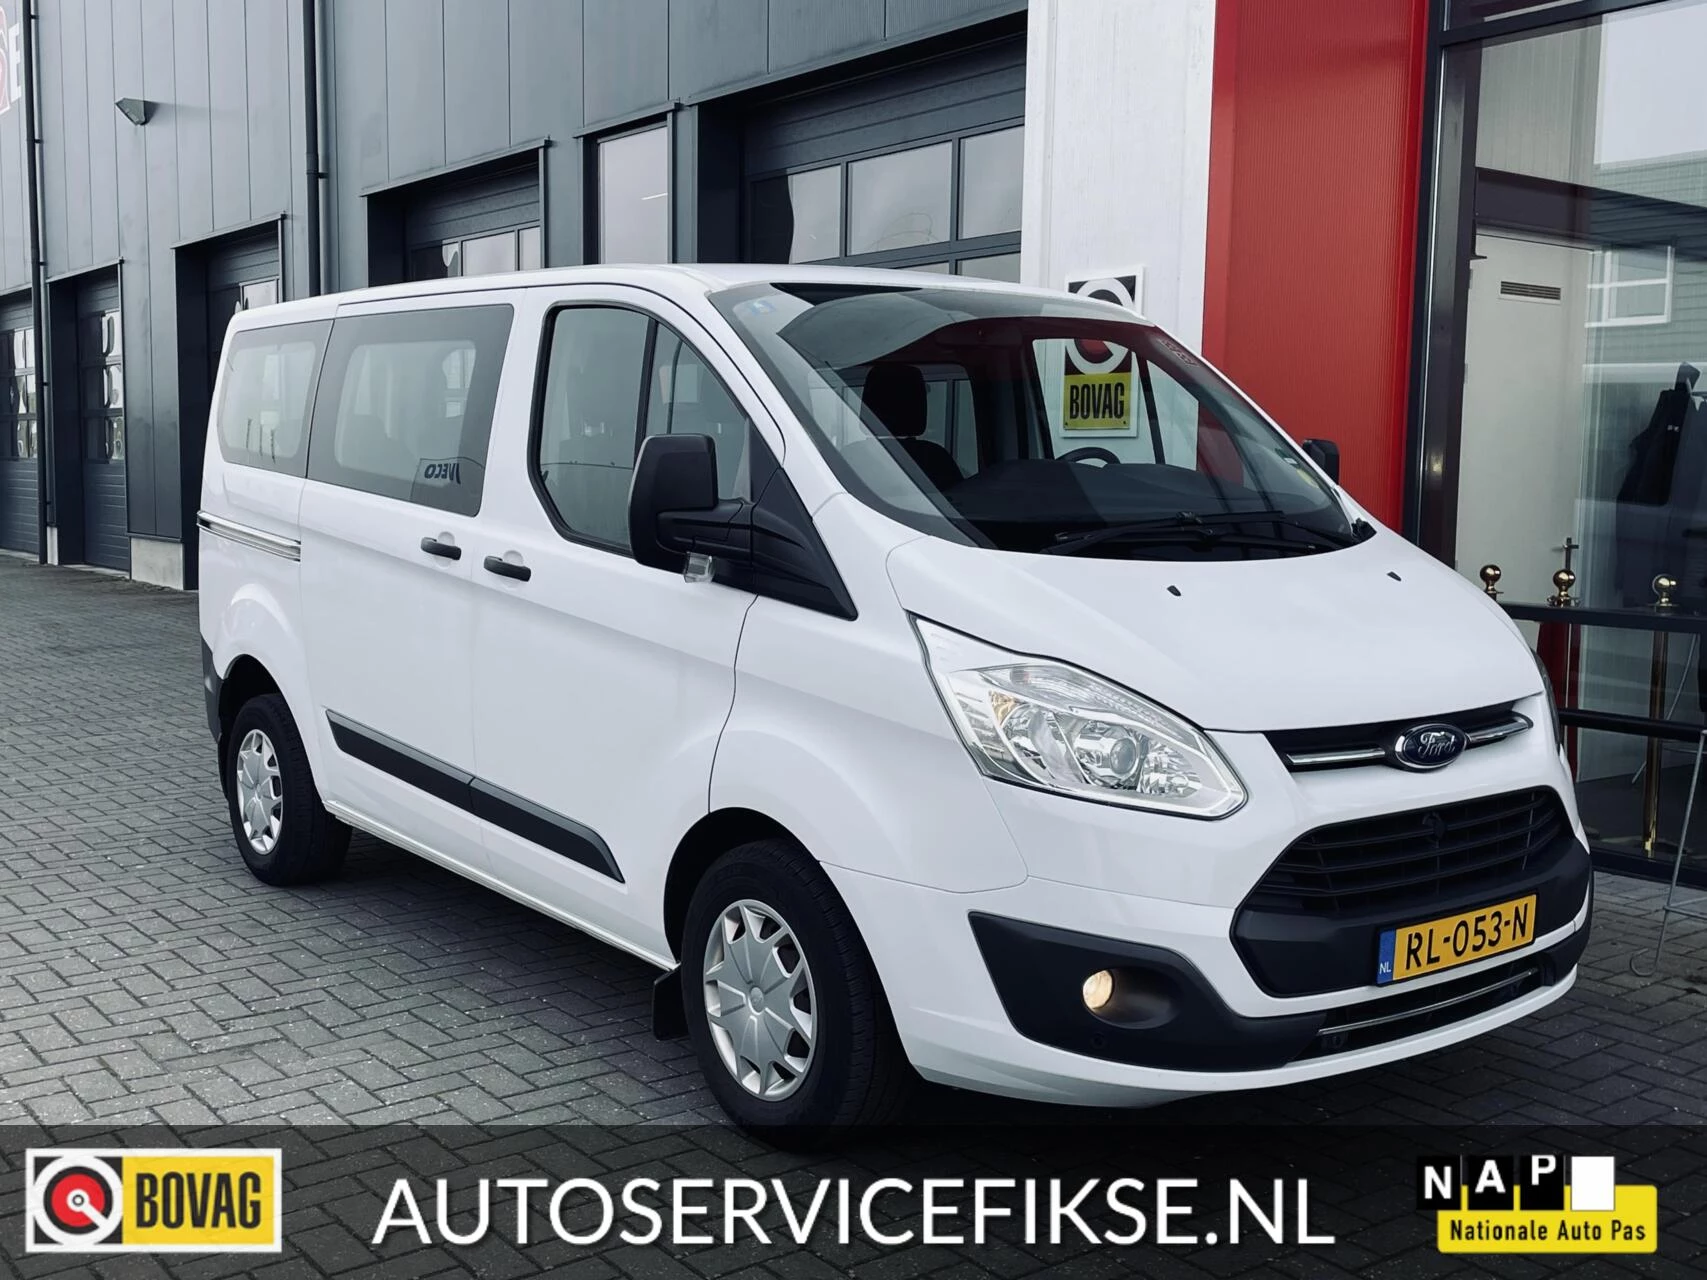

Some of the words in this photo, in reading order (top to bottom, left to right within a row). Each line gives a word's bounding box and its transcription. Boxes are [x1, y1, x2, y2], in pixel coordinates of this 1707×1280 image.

[1069, 382, 1125, 420] BOVAG
[1418, 731, 1457, 758] Ford
[1405, 903, 1528, 970] RL-053-N
[1379, 961, 1392, 973] NL
